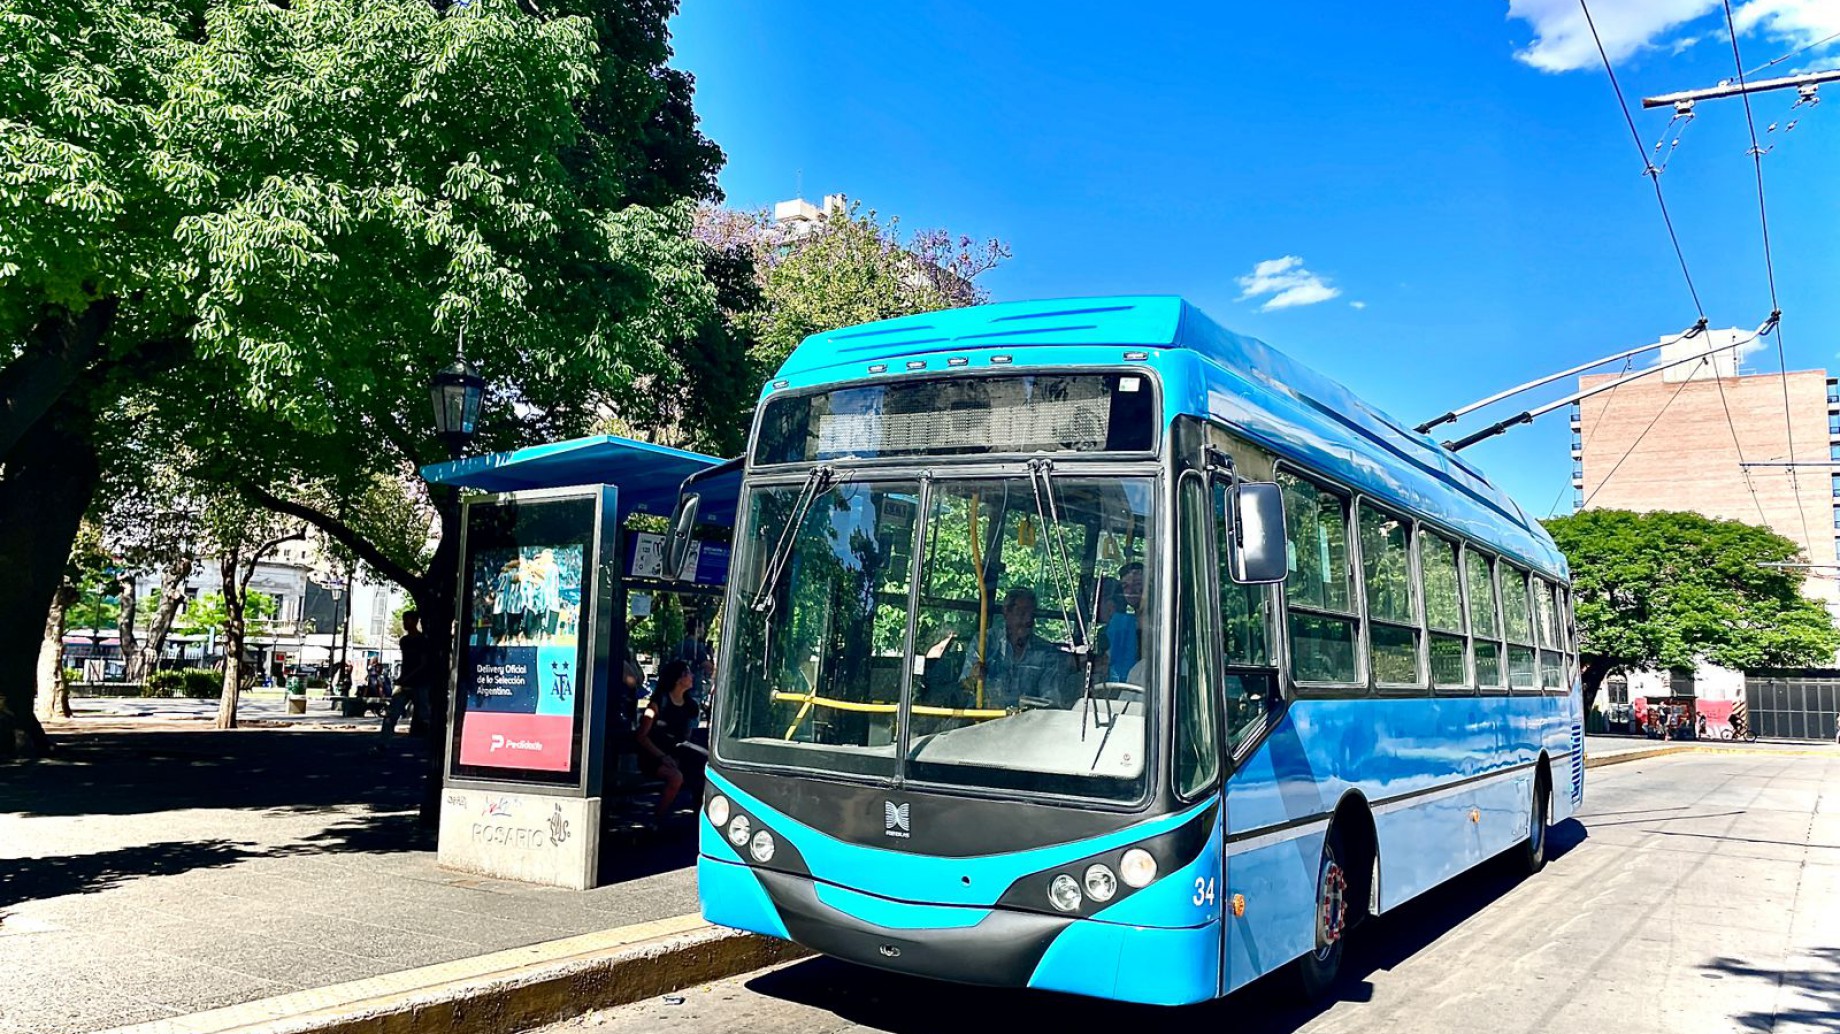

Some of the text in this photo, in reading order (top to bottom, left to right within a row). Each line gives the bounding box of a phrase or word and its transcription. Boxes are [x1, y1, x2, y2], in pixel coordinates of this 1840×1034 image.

[477, 665, 527, 675] Delivery Oficial
[477, 675, 485, 683] de
[494, 675, 525, 685] Selección
[551, 671, 572, 701] AFA
[477, 686, 513, 696] Argentina.
[472, 823, 545, 848] ROSARIO
[1193, 876, 1215, 906] 34
